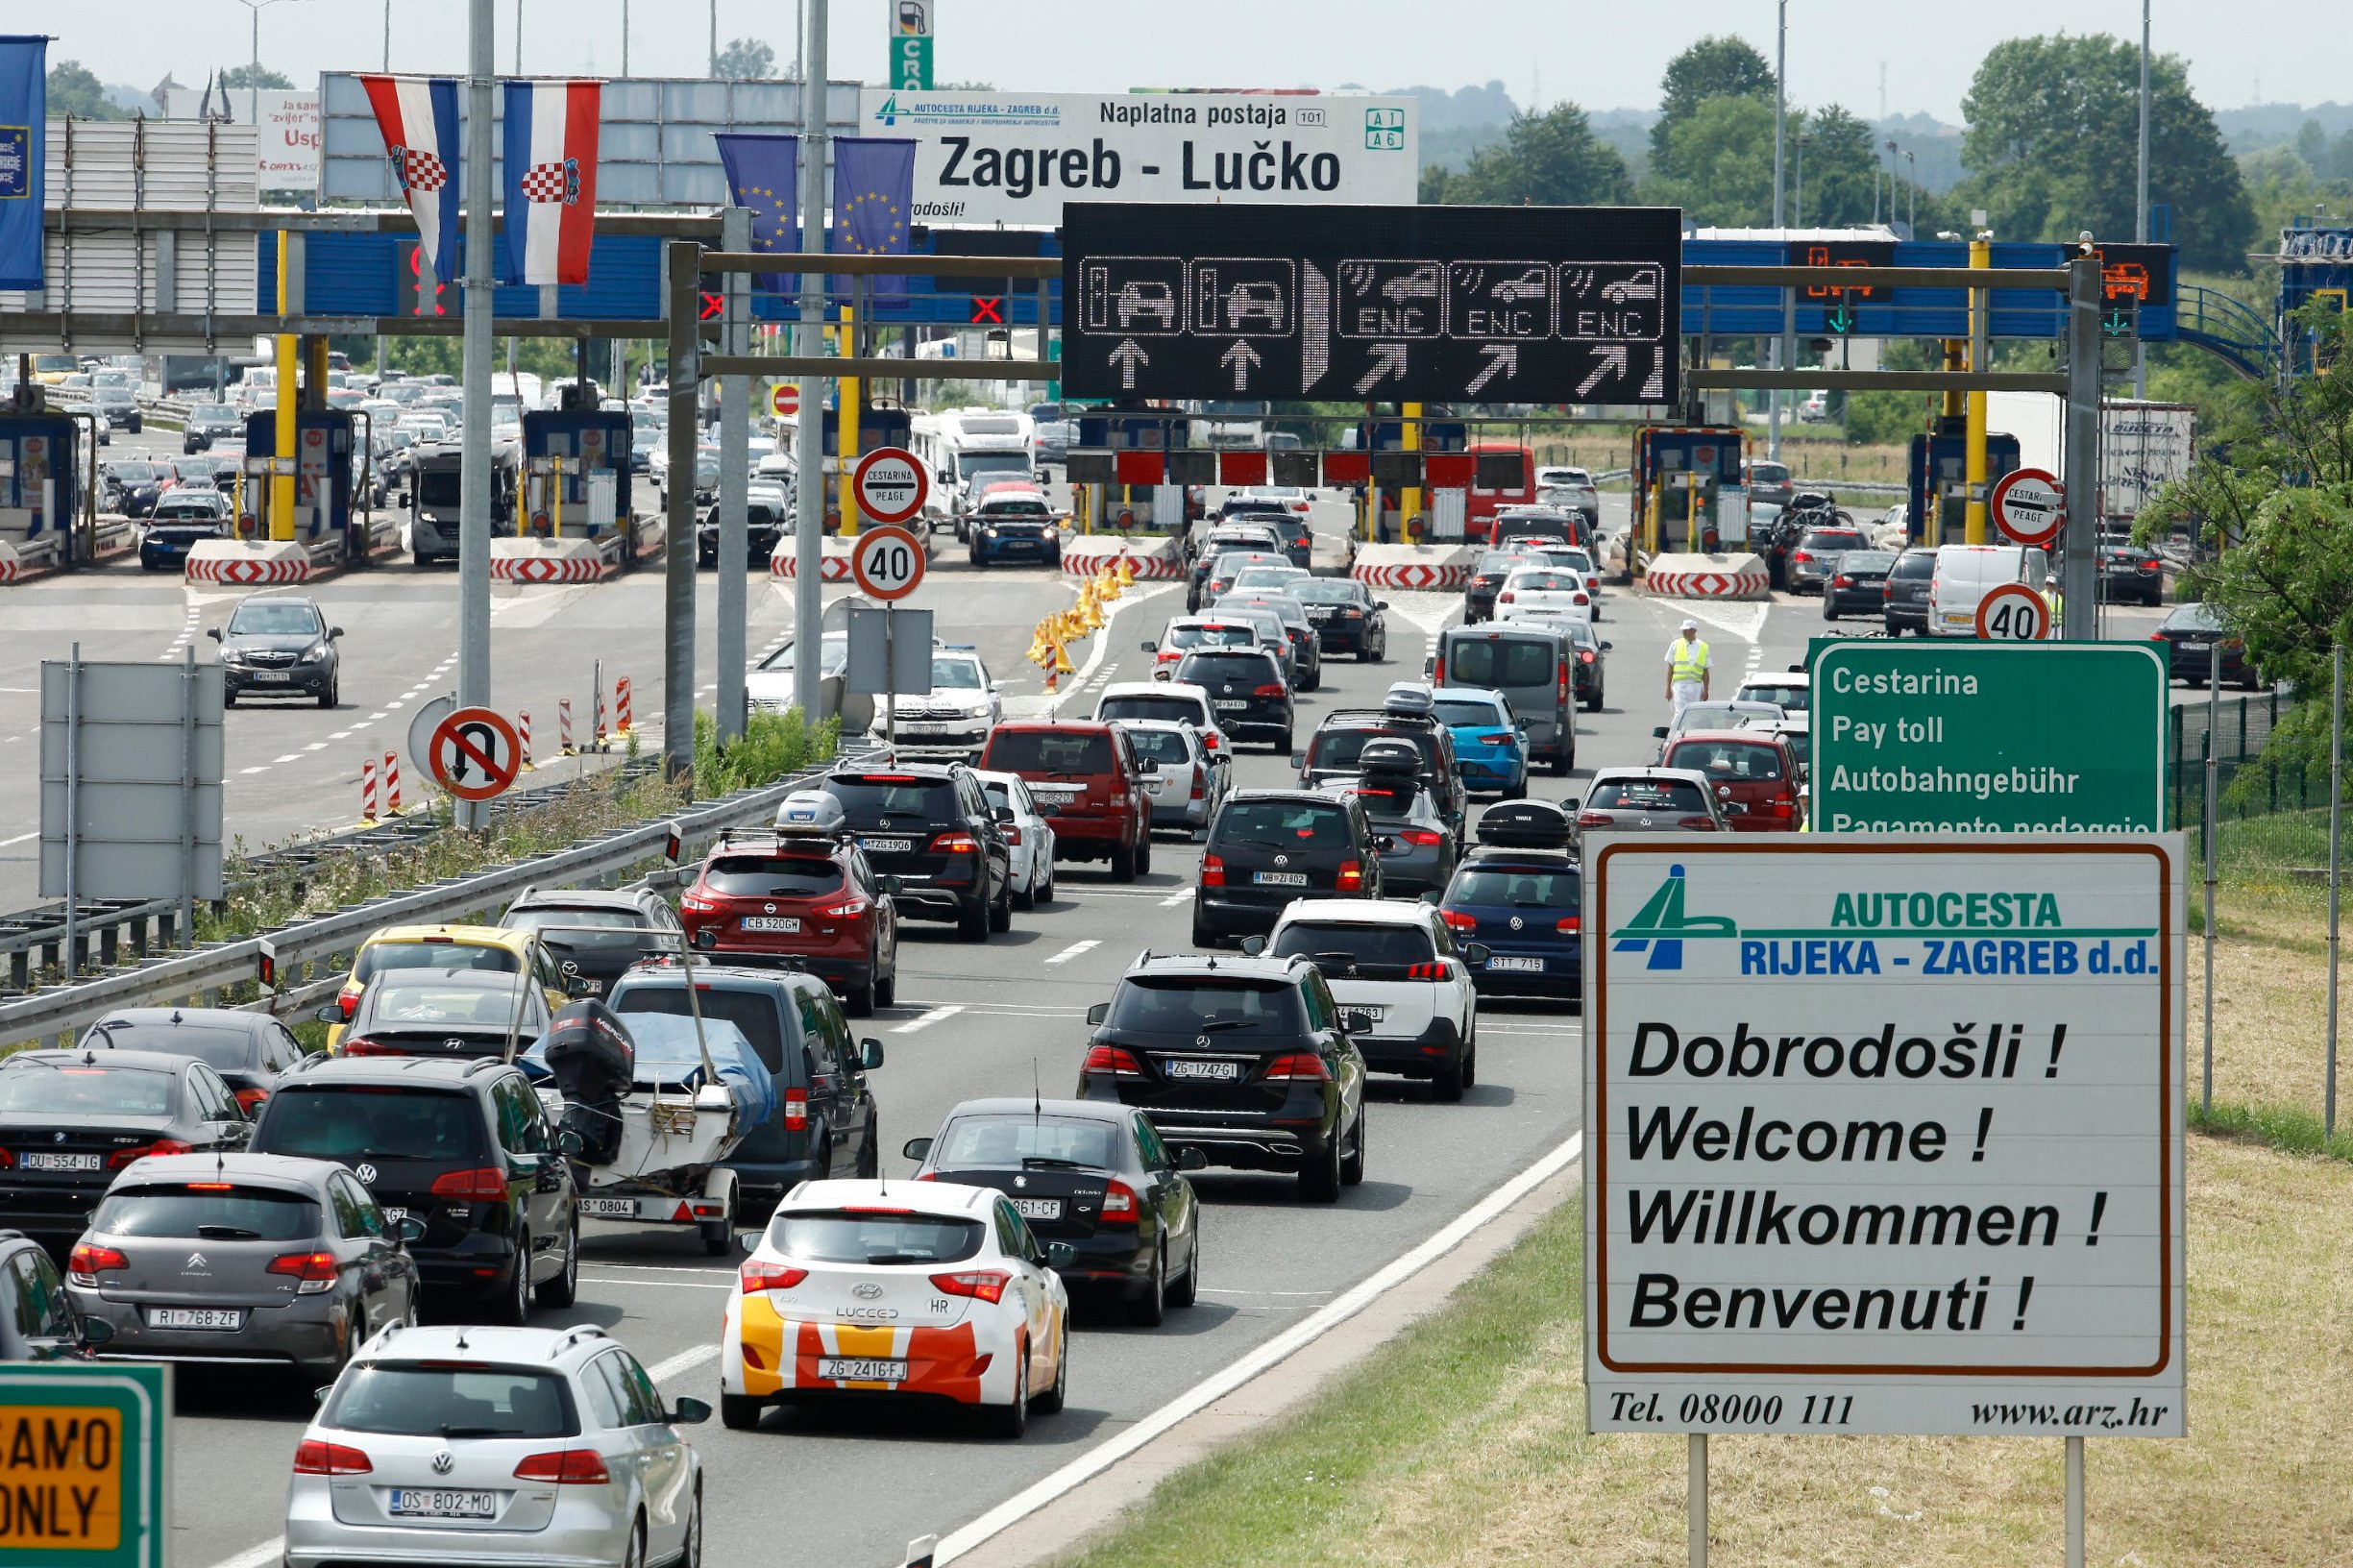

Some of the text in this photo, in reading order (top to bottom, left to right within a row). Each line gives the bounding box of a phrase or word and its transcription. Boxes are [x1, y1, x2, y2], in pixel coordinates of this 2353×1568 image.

[914, 103, 965, 113] AUTOCESTA
[968, 104, 998, 114] RIJEKA
[1007, 105, 1042, 114] ZAGREB
[1044, 106, 1061, 114] d.d.
[1100, 102, 1287, 129] Naplatna postaja
[1300, 111, 1322, 124] 101
[939, 136, 1341, 199] Zagreb - Lučko
[911, 202, 966, 217] odošli!
[1358, 307, 1424, 333] ENC
[1468, 309, 1532, 334] ENC
[1578, 311, 1642, 336] ENC
[868, 471, 913, 480] CESTARINA
[875, 491, 905, 502] PEAGE
[2013, 509, 2044, 524] PEAGE
[869, 546, 908, 581] 40
[1991, 603, 2034, 640] 40
[1833, 667, 1978, 695] Cestarina
[1833, 715, 1943, 748] Pay toll
[1830, 765, 2079, 799] Autobahngebühr
[1830, 892, 2062, 928] AUTOCESTA
[748, 918, 763, 928] CB
[1493, 958, 1541, 968] STT 715
[1741, 939, 2159, 975] RIJEKA - ZAGREB d.d.
[1628, 1022, 2068, 1079] Dobrodošli !
[1173, 1062, 1235, 1076] ZG 1747-GI
[1628, 1106, 1994, 1163] Welcome !
[30, 1155, 98, 1168] DU 554-IG
[600, 1200, 628, 1213] 0804
[1629, 1189, 2108, 1246] Willkommen !
[836, 1307, 898, 1319] LUCEED
[930, 1299, 948, 1314] HR
[1629, 1273, 2035, 1332] Benvenuti !
[159, 1311, 236, 1326] RI 768-ZF
[828, 1360, 906, 1377] ZG 2416-FJ
[1610, 1392, 1853, 1425] Tel. 08000 111
[1972, 1397, 2169, 1430] www.arz.hr
[0, 1417, 111, 1471] AMO
[402, 1491, 491, 1512] OS 802-MO
